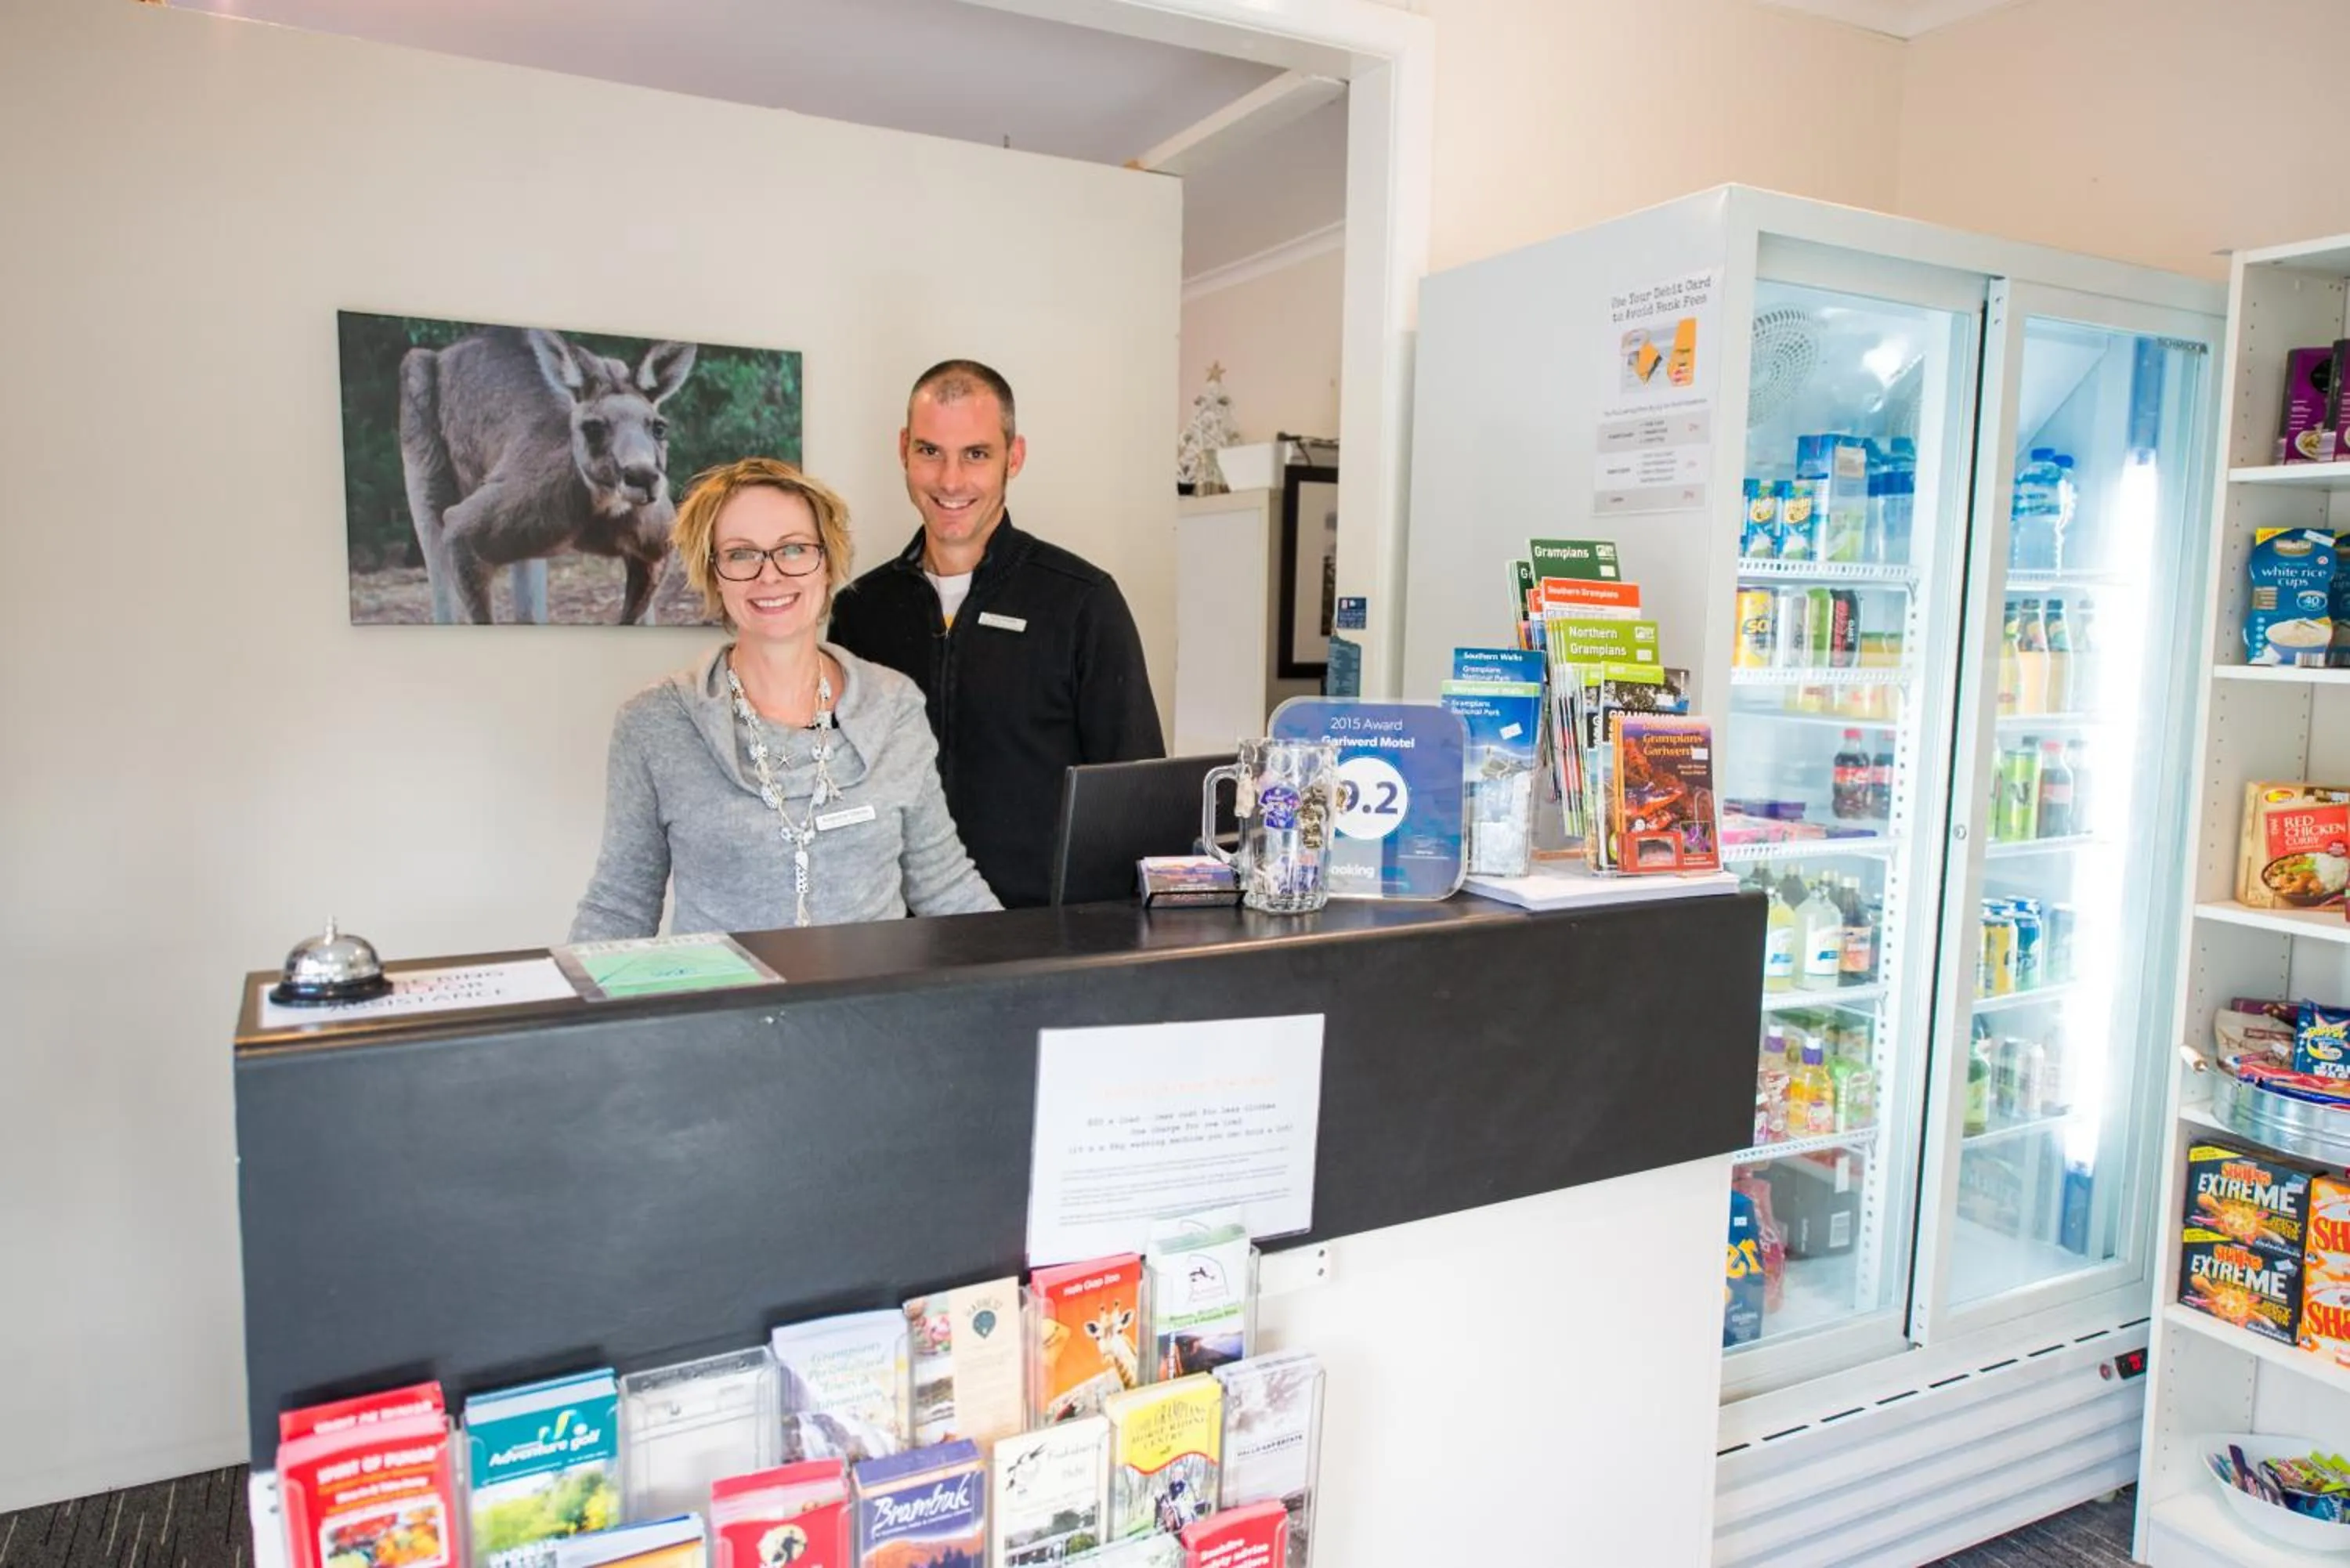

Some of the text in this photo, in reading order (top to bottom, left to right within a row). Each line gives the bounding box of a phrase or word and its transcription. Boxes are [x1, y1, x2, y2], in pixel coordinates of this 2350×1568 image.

[1535, 545, 1589, 561] Grampians
[2261, 565, 2327, 578] white rice
[2277, 578, 2309, 589] cups
[1569, 626, 1618, 639] Northern
[1462, 651, 1499, 660] Southern
[1570, 641, 1627, 657] Grampians
[1330, 717, 1404, 731] 2015 Award
[1379, 736, 1415, 749] Motel
[1643, 732, 1705, 749] Grampians
[2283, 814, 2316, 829] RED
[2283, 822, 2347, 838] CHICKEN
[2285, 836, 2319, 847] CURRY
[1330, 863, 1376, 879] ooking
[2197, 1172, 2301, 1215] EXTREME
[2190, 1253, 2288, 1300] EXTREME
